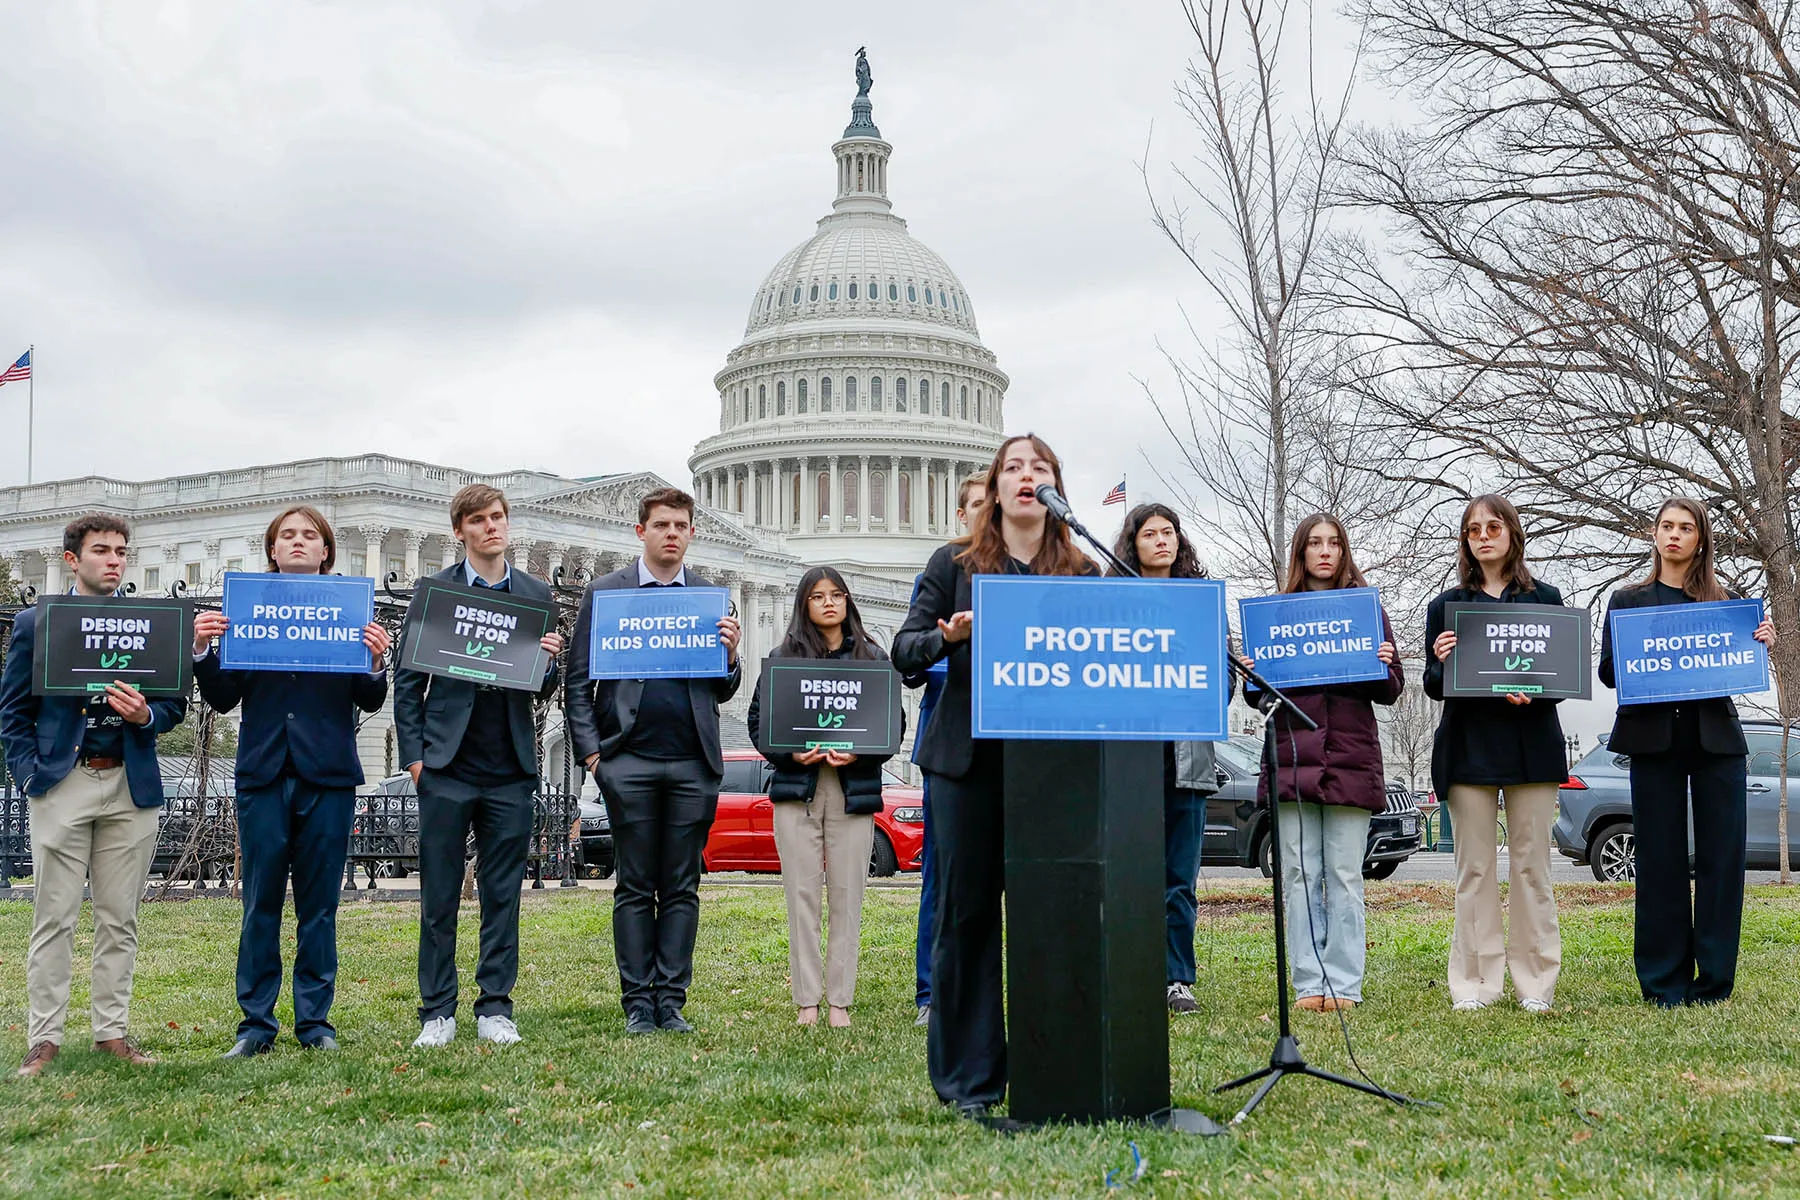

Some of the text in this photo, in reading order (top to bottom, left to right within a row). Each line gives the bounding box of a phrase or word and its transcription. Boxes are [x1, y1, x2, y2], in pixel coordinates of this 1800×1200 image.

[254, 604, 342, 620] PROTECT
[455, 605, 517, 629] DESIGN
[82, 618, 150, 633] DESIGN
[619, 616, 699, 630] PROTECT
[1270, 620, 1352, 639] PROTECT
[1486, 624, 1550, 638] DESIGN
[234, 625, 359, 641] KIDS ONLINE
[455, 622, 510, 643] IT FOR
[1026, 627, 1175, 652] PROTECT
[86, 635, 145, 649] IT FOR
[602, 635, 716, 650] KIDS ONLINE
[1255, 637, 1372, 659] KIDS ONLINE
[1490, 640, 1546, 653] IT FOR
[1644, 632, 1732, 652] PROTECT
[1627, 650, 1754, 673] KIDS ONLINE
[994, 662, 1207, 688] KIDS ONLINE
[801, 680, 861, 694] DESIGN
[805, 696, 857, 710] IT FOR
